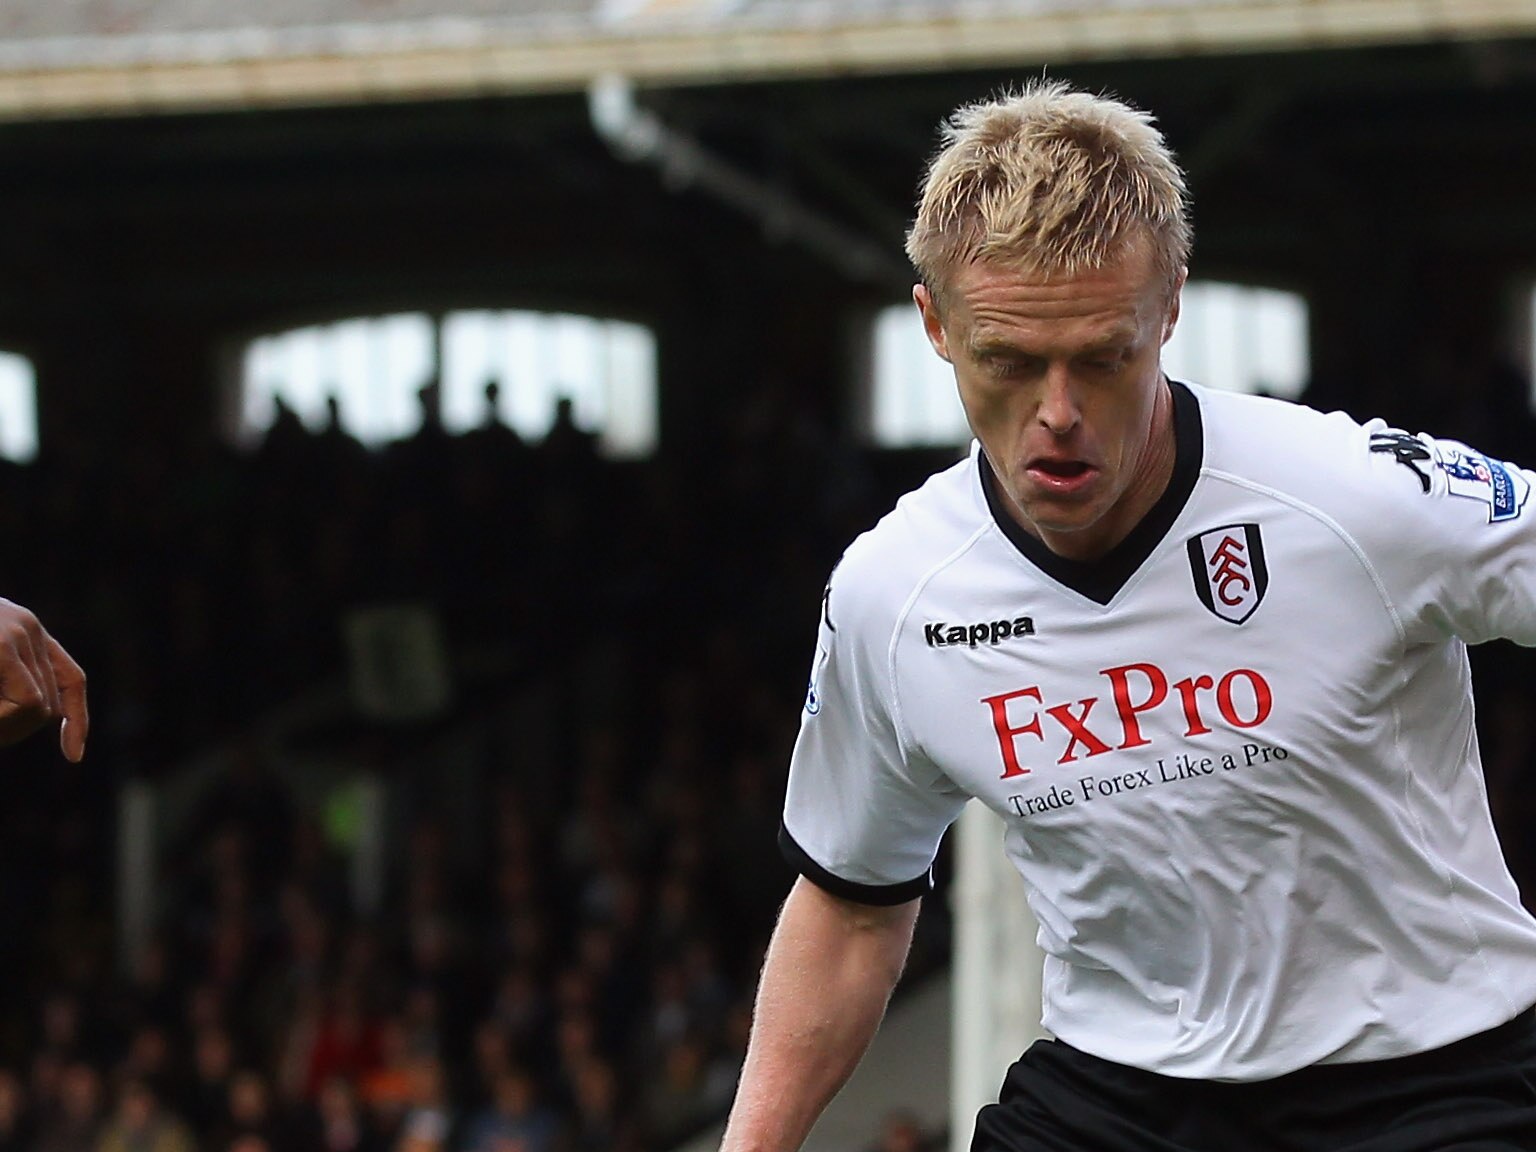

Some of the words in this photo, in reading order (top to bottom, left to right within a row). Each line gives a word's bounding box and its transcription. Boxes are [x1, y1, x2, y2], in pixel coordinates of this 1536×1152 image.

[924, 614, 1036, 650] Kappa
[980, 661, 1275, 780] FxPro
[1008, 784, 1075, 818] Trade
[1079, 769, 1153, 803] Forex
[1156, 755, 1215, 784] Like
[1221, 754, 1238, 771] a
[1243, 743, 1289, 768] Pro
